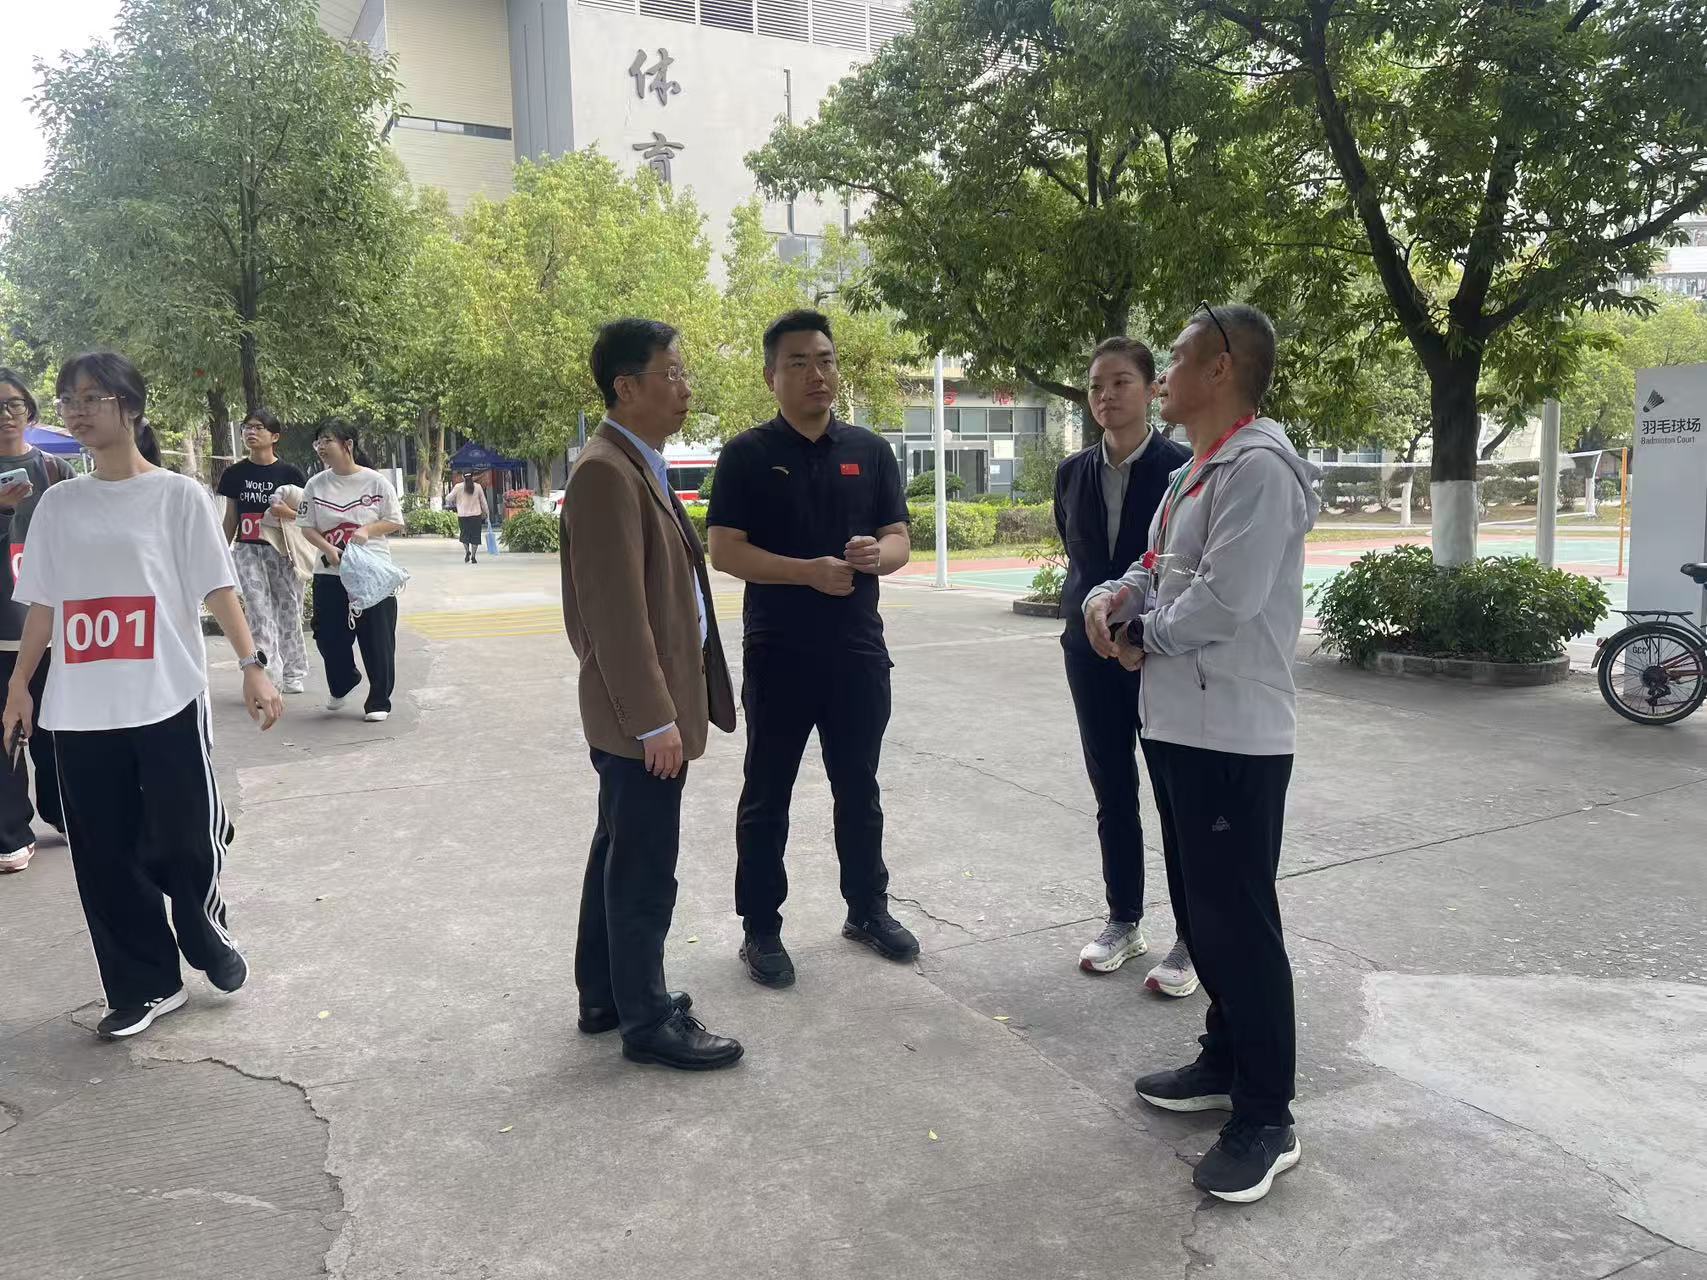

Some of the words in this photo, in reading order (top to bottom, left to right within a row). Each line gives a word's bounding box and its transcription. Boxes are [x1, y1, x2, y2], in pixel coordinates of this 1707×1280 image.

[1641, 417, 1701, 435] 羽毛球场
[1640, 436, 1675, 445] Badminton
[1676, 435, 1695, 444] Court
[245, 480, 274, 492] WORLD
[66, 609, 146, 651] 001
